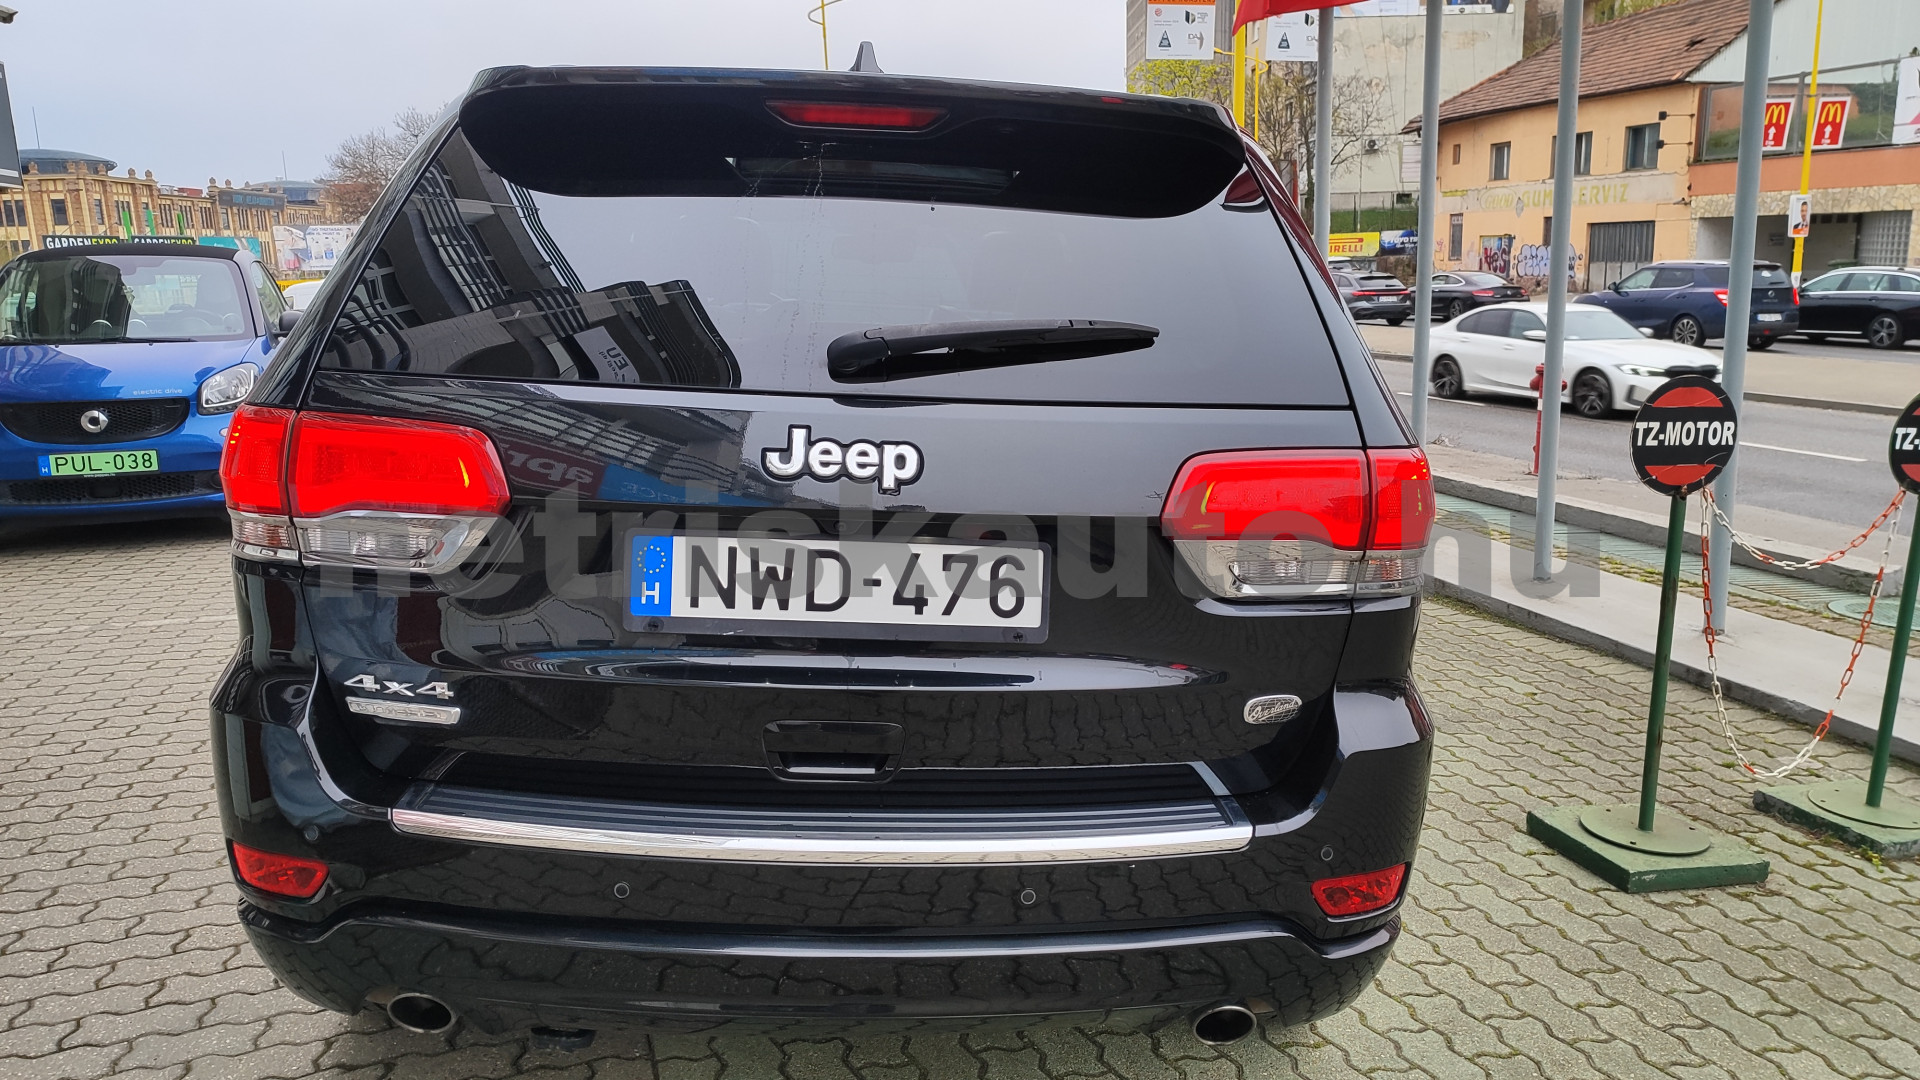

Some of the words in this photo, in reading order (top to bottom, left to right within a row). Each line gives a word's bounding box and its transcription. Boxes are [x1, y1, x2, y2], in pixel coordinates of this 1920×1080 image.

[1329, 244, 1363, 253] IRELLI
[1635, 421, 1736, 446] TZ-MOTOR
[1895, 427, 1920, 451] TZ-
[54, 452, 153, 474] PUL-038
[763, 425, 922, 493] Jeep
[640, 581, 661, 605] H
[689, 544, 1026, 619] NWD-476
[343, 673, 455, 700] 4x4
